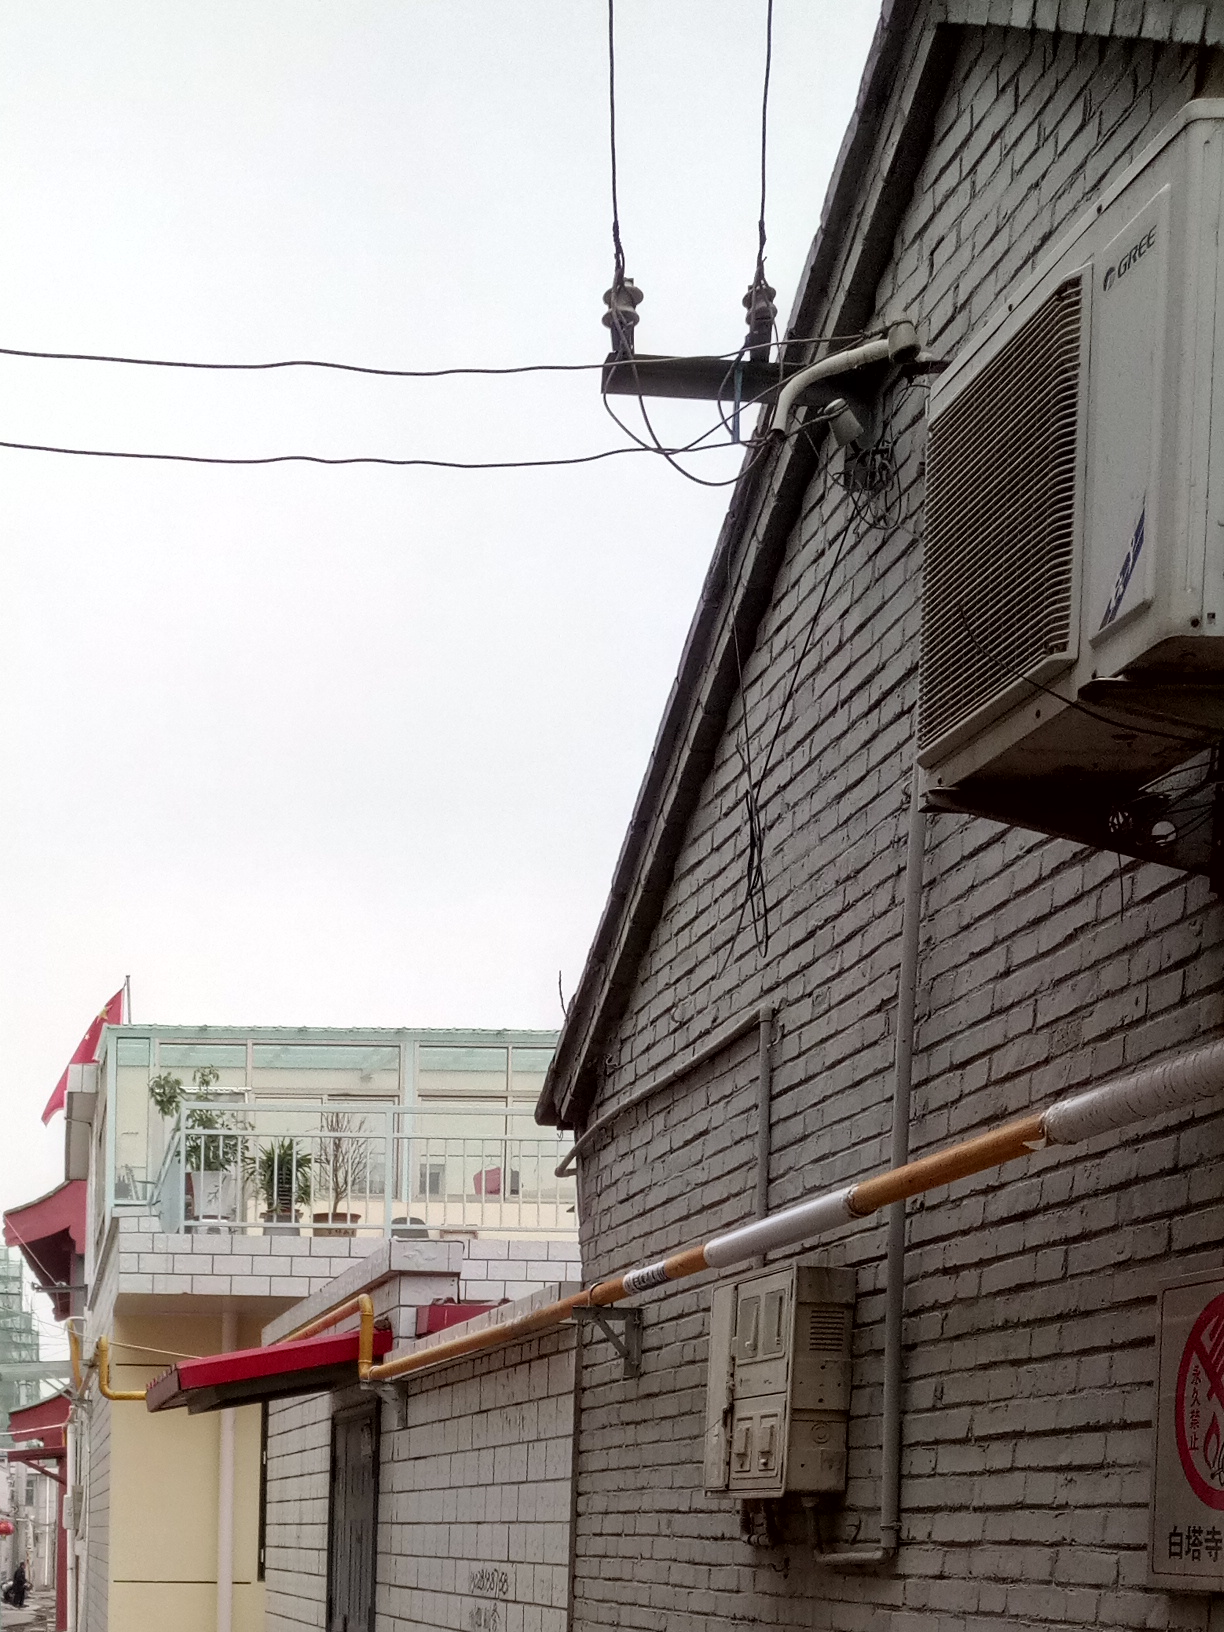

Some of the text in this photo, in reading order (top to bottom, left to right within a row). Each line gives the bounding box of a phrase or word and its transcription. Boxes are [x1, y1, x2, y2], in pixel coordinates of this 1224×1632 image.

[1117, 224, 1157, 279] GREE
[1189, 1364, 1202, 1452] 永久禁止
[1168, 1525, 1223, 1562] 白塔寺
